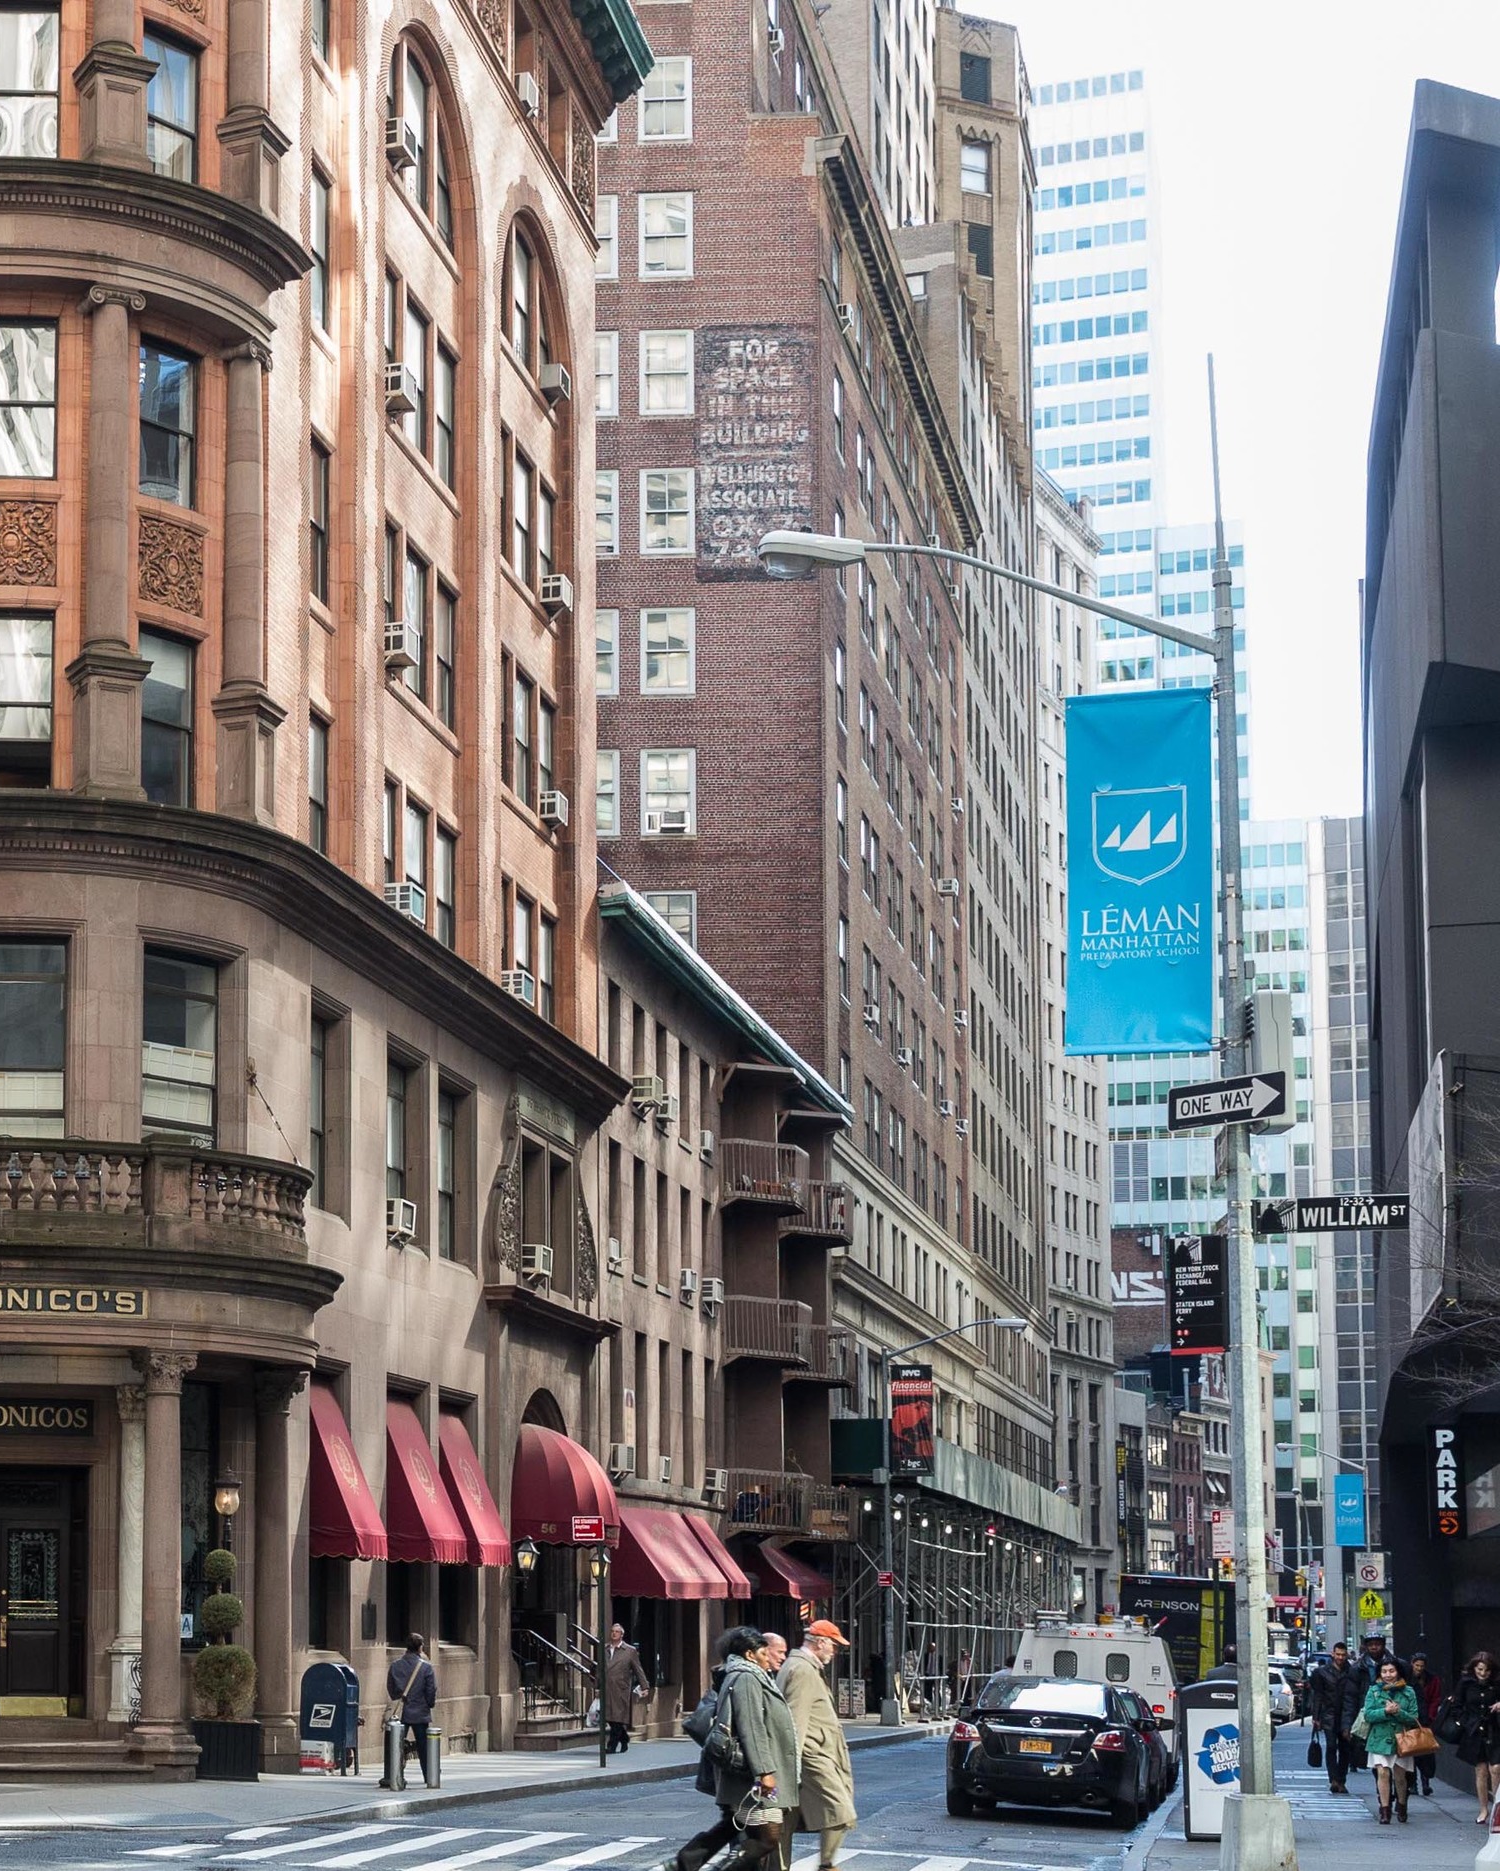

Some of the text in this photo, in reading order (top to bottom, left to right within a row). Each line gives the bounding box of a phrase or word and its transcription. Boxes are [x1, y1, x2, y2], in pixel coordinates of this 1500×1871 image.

[1081, 902, 1200, 937] LÉMAN
[1081, 931, 1200, 951] MANHATTAN
[1080, 946, 1200, 961] PREPARATORY SCHOOL
[1180, 1089, 1254, 1117] ONE WAY
[1339, 1197, 1364, 1207] 12-32
[1301, 1204, 1406, 1228] WILLIAM ST
[901, 1369, 921, 1377] NYC
[891, 1381, 932, 1391] financial
[907, 1459, 921, 1468] bgc
[1435, 1429, 1459, 1509] PARK
[541, 1523, 557, 1534] 56
[1134, 1599, 1199, 1612] ARENSON
